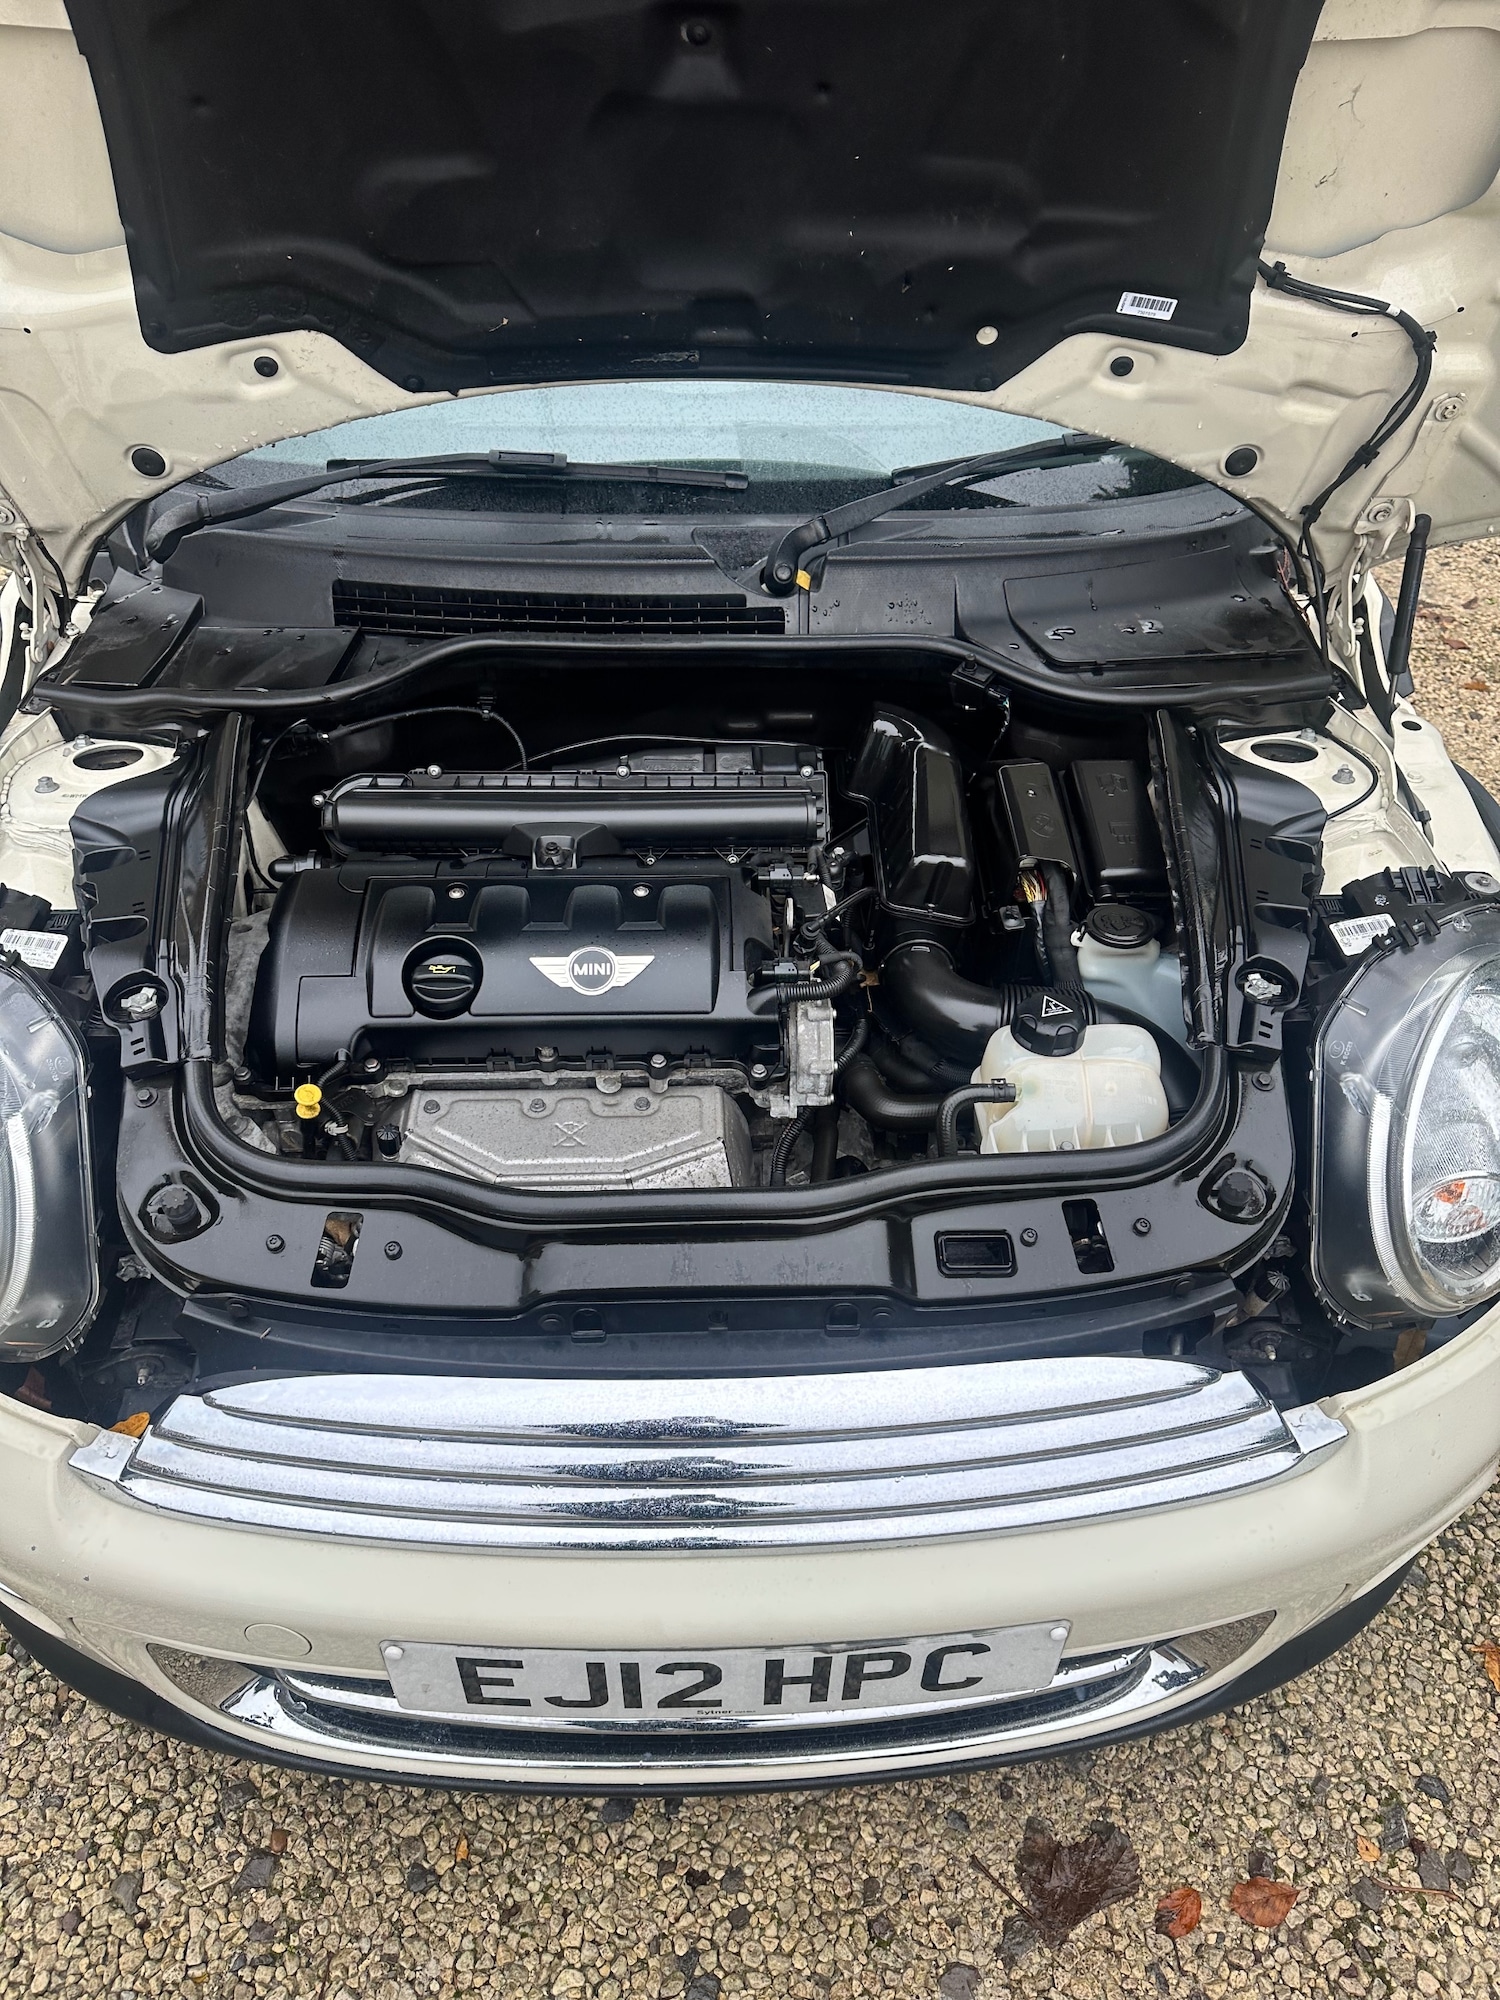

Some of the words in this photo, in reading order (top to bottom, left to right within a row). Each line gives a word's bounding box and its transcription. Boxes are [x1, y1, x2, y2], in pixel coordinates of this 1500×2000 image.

[573, 962, 611, 976] MINI
[455, 1657, 723, 1709] EJ12
[763, 1642, 991, 1705] HPC
